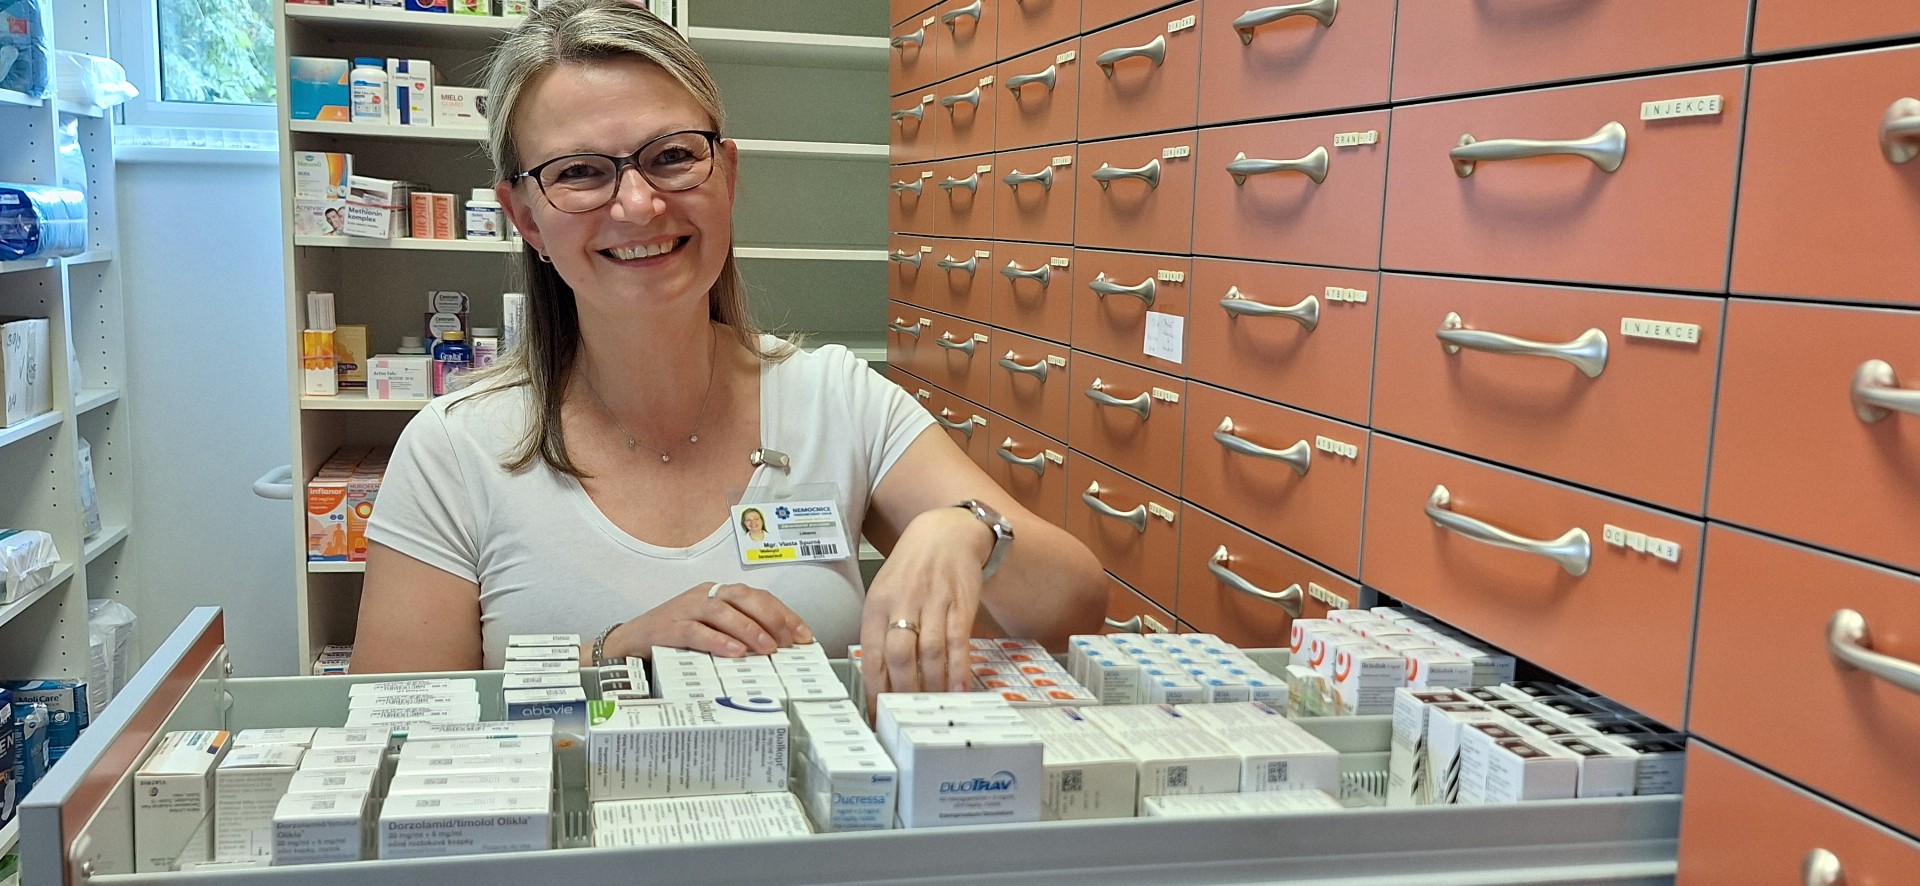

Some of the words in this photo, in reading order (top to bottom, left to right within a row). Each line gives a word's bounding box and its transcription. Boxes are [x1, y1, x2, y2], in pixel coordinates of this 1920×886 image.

[440, 93, 464, 102] MIELO
[1643, 99, 1716, 117] INJEKCE
[347, 214, 377, 223] komplex
[348, 206, 383, 218] Methionin
[1623, 321, 1695, 340] INJEKCE
[17, 694, 60, 703] MoliCare
[521, 703, 574, 717] abbvie
[775, 728, 788, 769] Dualkopt
[388, 817, 495, 831] Dorzolamid/timolol
